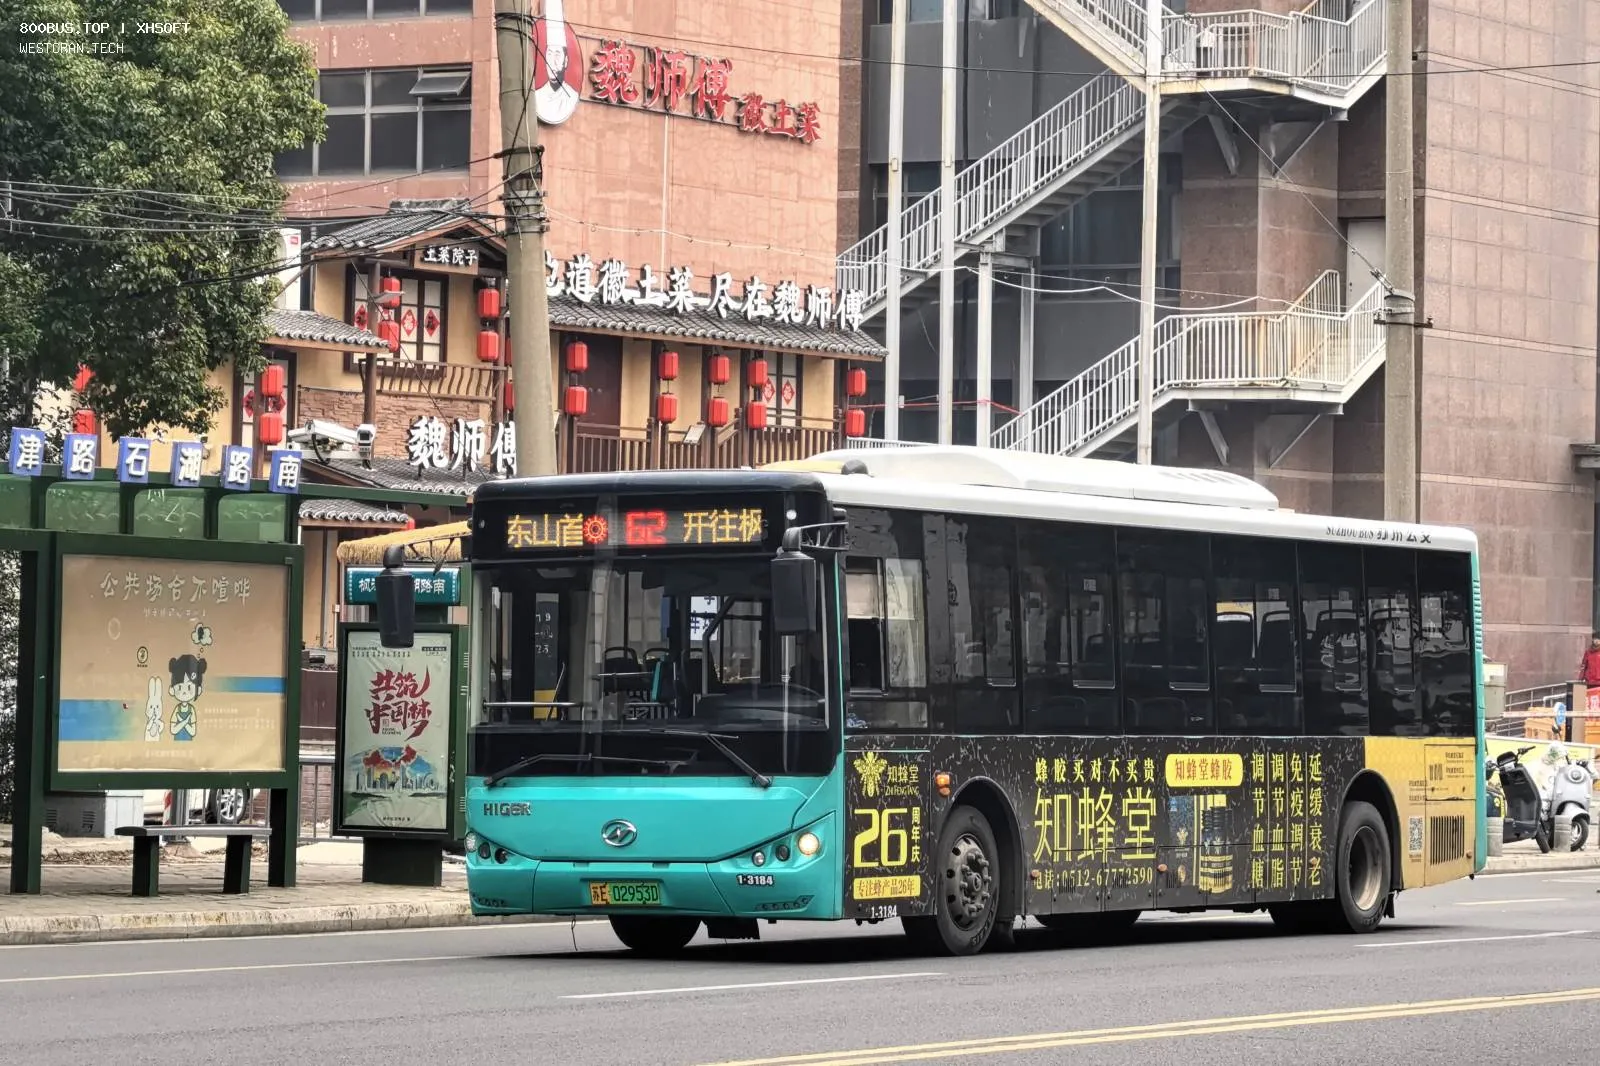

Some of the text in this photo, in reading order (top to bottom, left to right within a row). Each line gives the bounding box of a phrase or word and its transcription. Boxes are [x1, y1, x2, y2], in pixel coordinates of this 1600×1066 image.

[591, 39, 733, 120] 魏师傅
[424, 245, 478, 266] 土菜院子
[408, 415, 517, 475] 魏师傅
[624, 509, 667, 546] 62
[100, 571, 251, 606] 公共场合不喧哗
[364, 697, 432, 741] 中国梦
[886, 763, 919, 783] 知蜂堂
[1035, 756, 1155, 784] 蜂胶买对不买贵
[1174, 757, 1233, 781] 知蜂堂蜂胶
[483, 802, 532, 816] HIGER
[1033, 787, 1157, 863] 知蜂堂
[853, 807, 908, 868] 26
[911, 806, 921, 863] 周年庆
[871, 904, 898, 919] 1-3184
